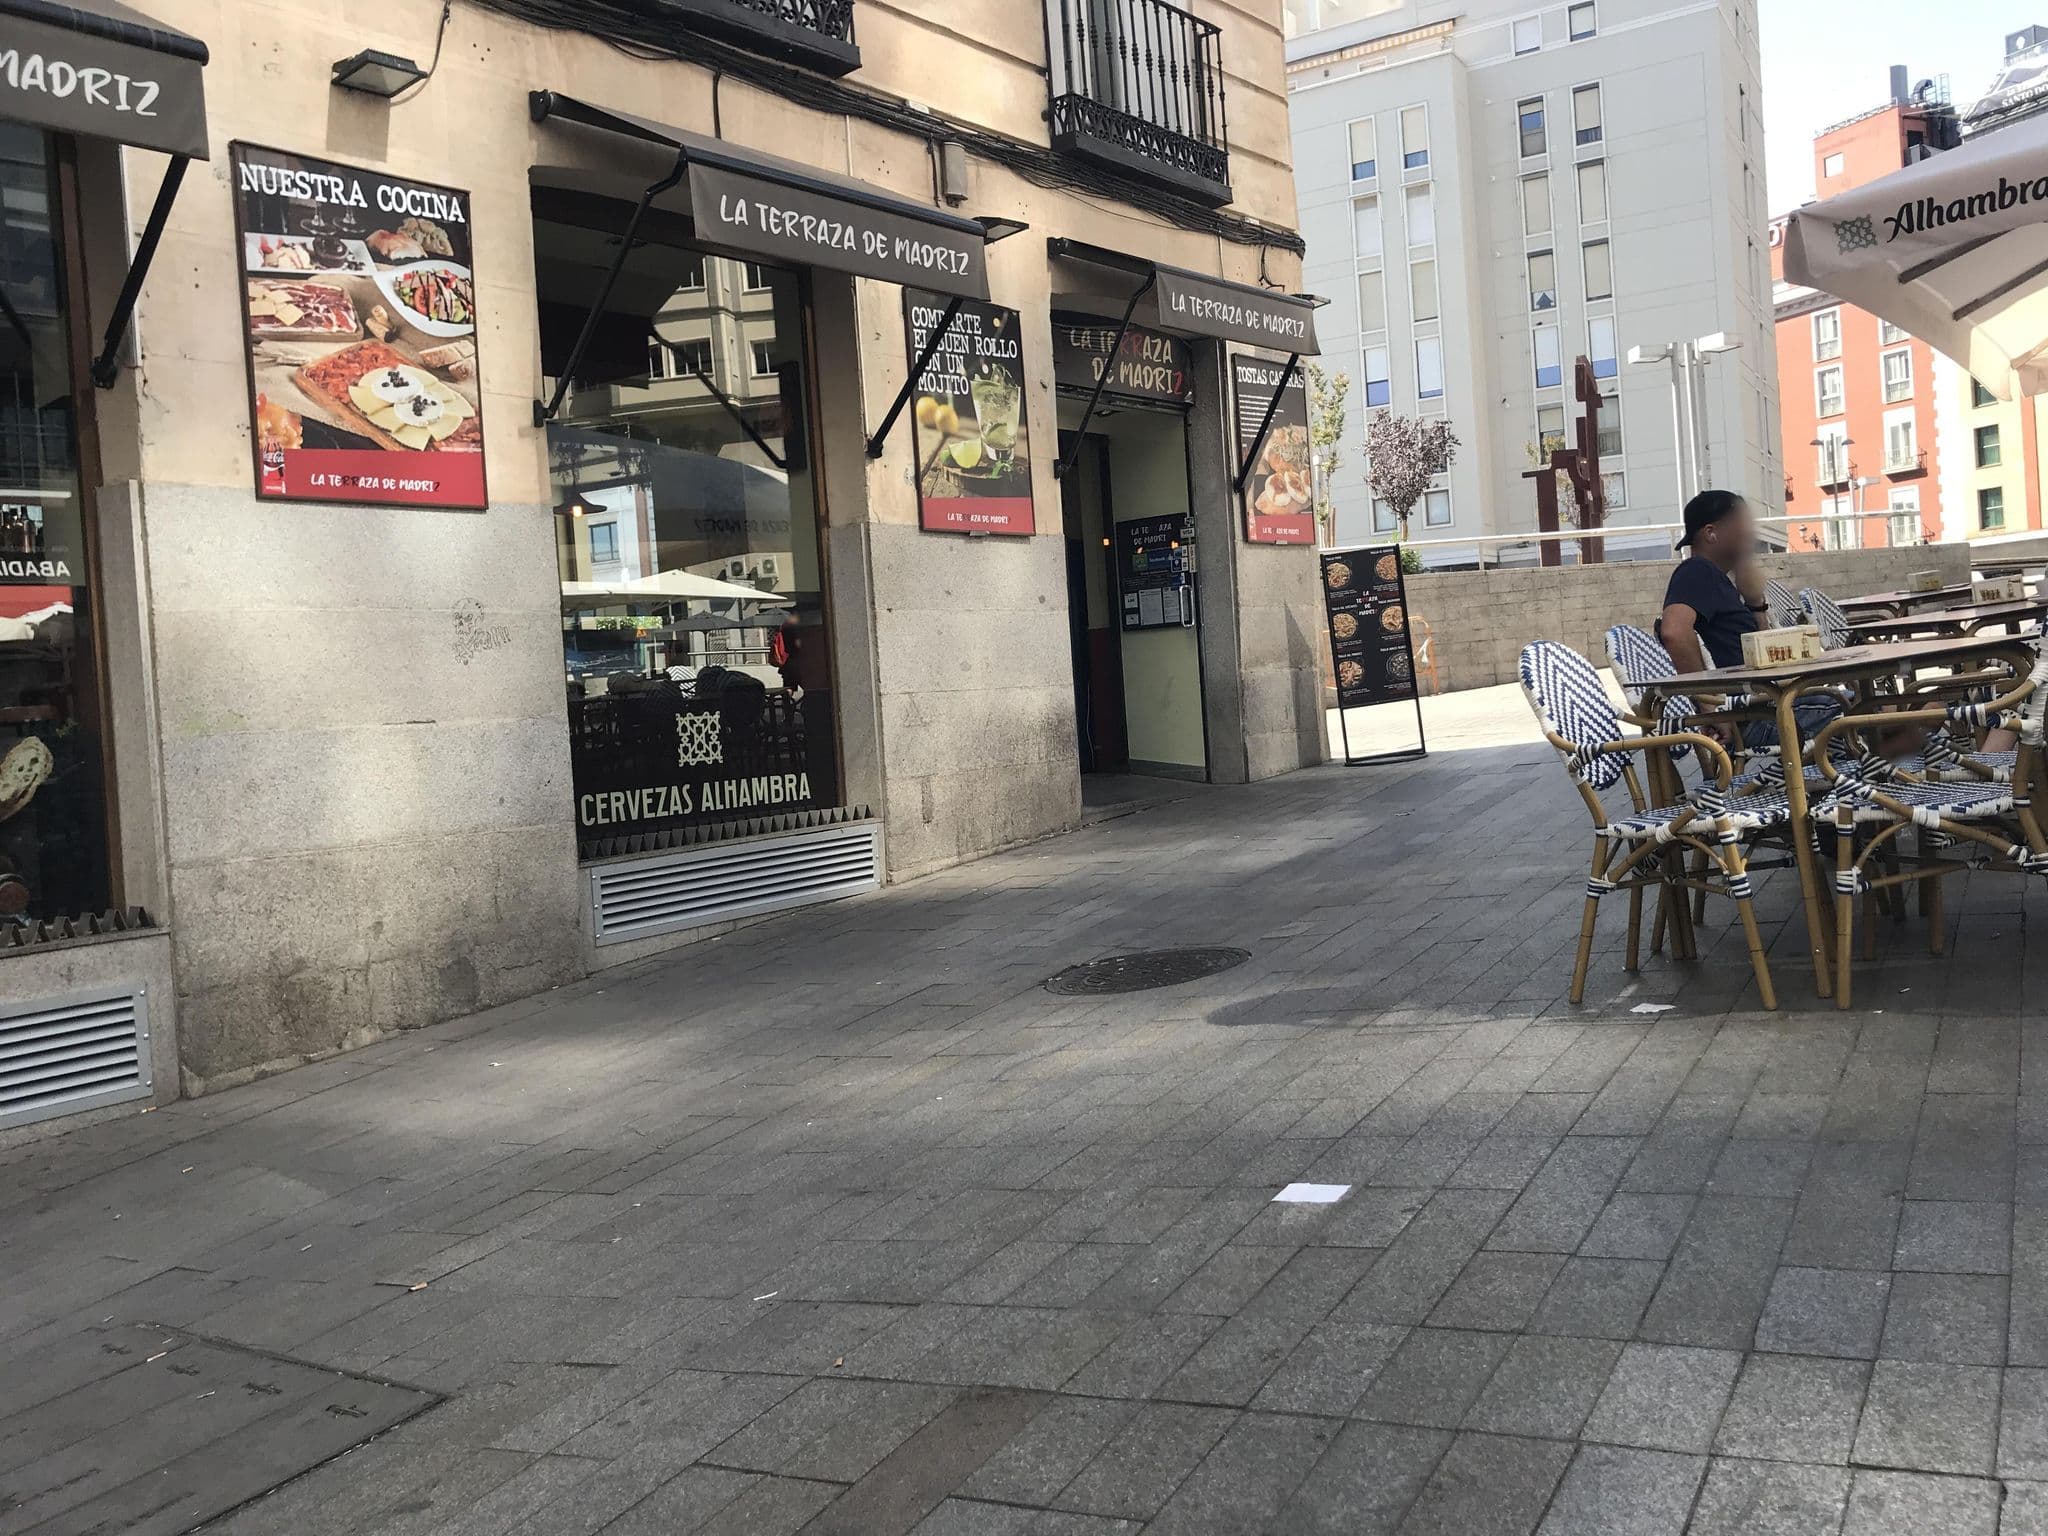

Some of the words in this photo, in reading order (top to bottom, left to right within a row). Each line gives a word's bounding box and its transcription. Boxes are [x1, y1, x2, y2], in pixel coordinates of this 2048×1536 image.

[0, 49, 160, 117] MADRIZ
[239, 163, 368, 208] NUESTRA
[377, 184, 466, 223] COCINA
[1883, 176, 2048, 244] Alhambra
[720, 194, 749, 226] LA
[755, 202, 857, 251] TERRAZA
[862, 230, 888, 259] DE
[894, 237, 969, 276] MADRIZ
[1172, 291, 1187, 313] LA
[1189, 295, 1243, 326] TERRAZA
[1245, 309, 1260, 330] DE
[1263, 313, 1305, 338] MADRIZ
[974, 336, 1018, 359] ROLLO
[1070, 329, 1092, 350] LA
[946, 353, 964, 374] UN
[918, 372, 969, 395] MOJITO
[1119, 361, 1184, 395] MADRIZ
[1237, 366, 1268, 386] TOSTAS
[1269, 370, 1304, 389] CASRAS
[311, 473, 325, 486] LA
[328, 474, 379, 489] TERRAZA
[382, 478, 396, 490] DE
[399, 479, 441, 493] MADRIZ
[947, 512, 955, 521] LA
[1131, 528, 1140, 536] LA
[1133, 537, 1143, 546] DE
[1144, 534, 1167, 544] MADRI
[580, 783, 694, 827] CERVEZAS
[701, 772, 811, 812] ALHAMBRA
